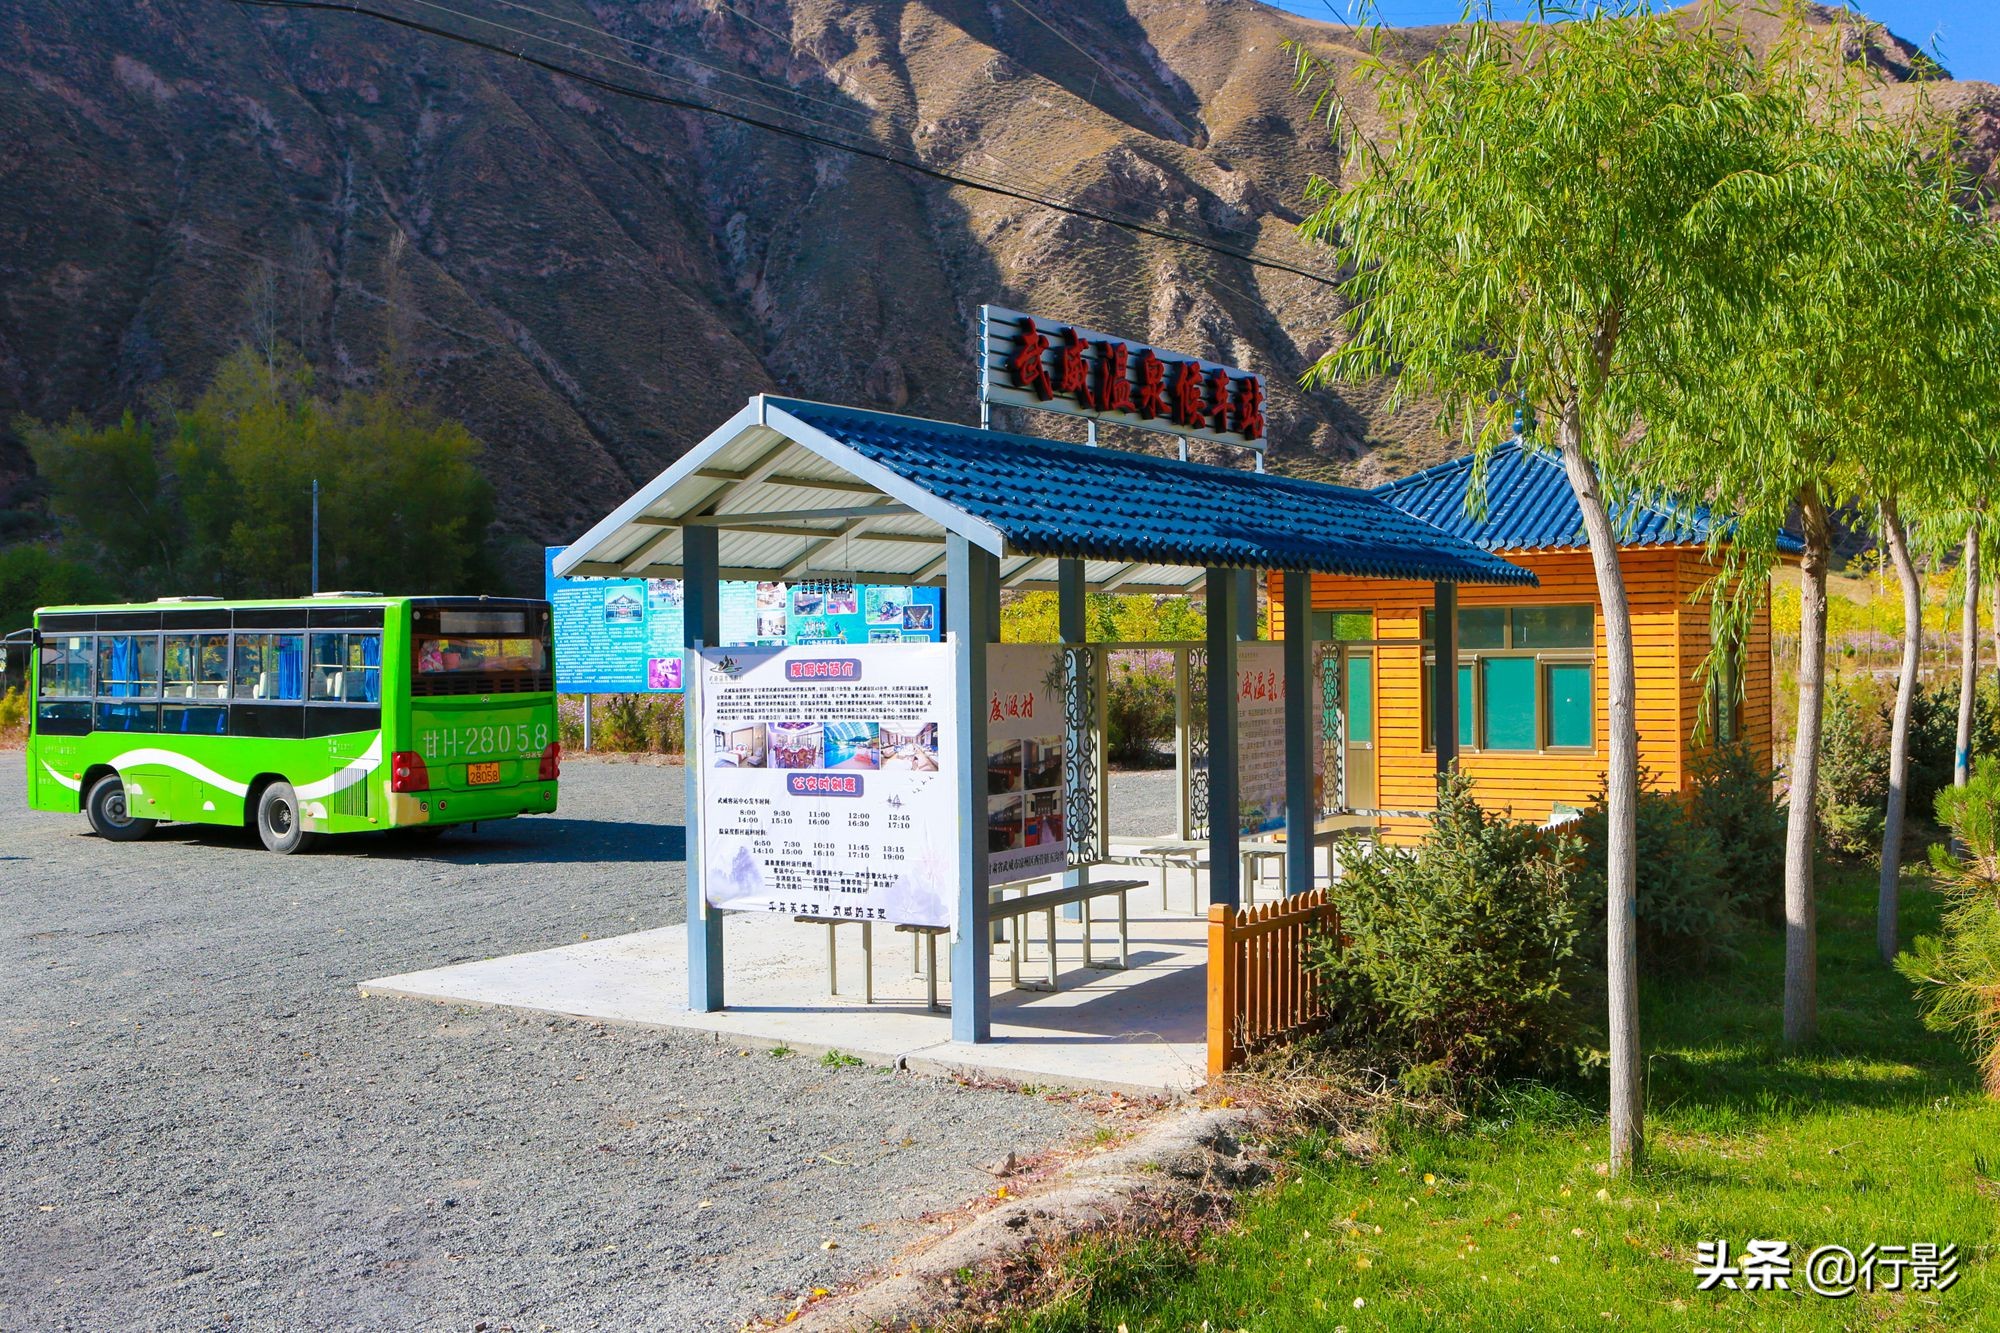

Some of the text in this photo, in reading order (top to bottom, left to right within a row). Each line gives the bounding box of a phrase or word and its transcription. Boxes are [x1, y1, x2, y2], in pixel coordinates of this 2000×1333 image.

[791, 662, 854, 677] 度假村简介
[989, 692, 1035, 724] 度假村
[423, 724, 548, 758] 甘H-28058
[471, 771, 498, 783] 28058
[793, 776, 855, 792] 公交时刻表
